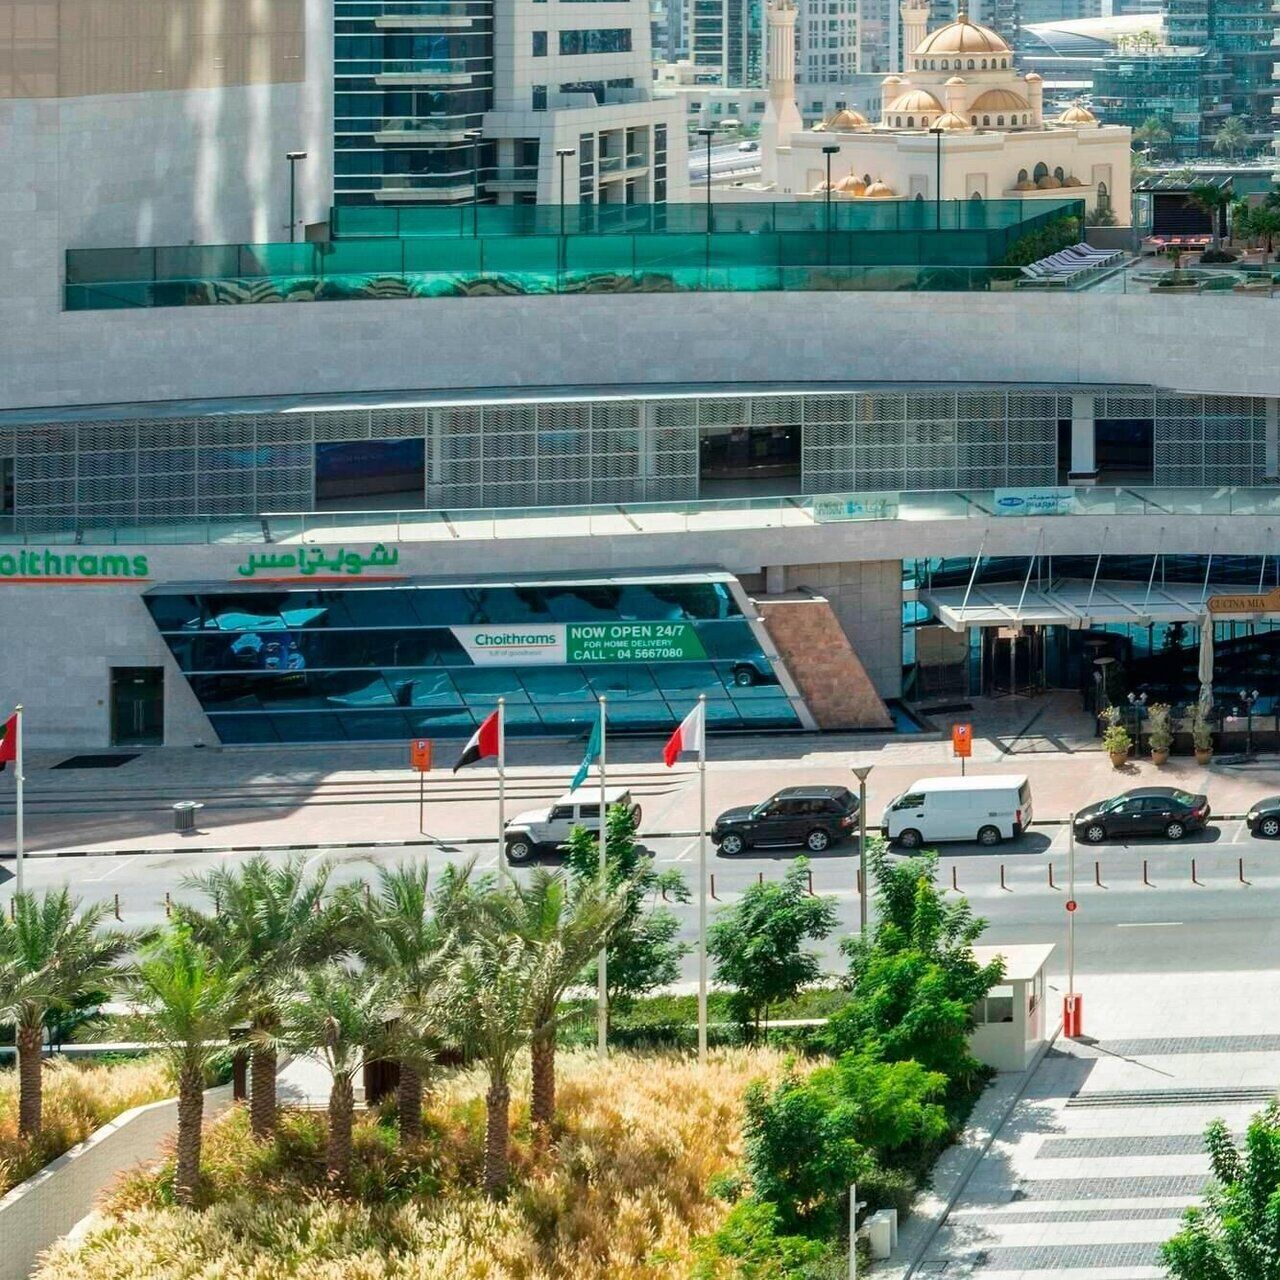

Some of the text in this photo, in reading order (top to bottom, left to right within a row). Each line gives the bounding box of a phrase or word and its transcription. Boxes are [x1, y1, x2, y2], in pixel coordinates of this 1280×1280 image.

[0, 548, 148, 576] oithrams
[475, 632, 556, 646] Choithrams
[571, 625, 685, 639] NOW OPEN 24/7
[584, 639, 673, 649] FOR HOME DELIVERY
[573, 650, 606, 660] CALL
[617, 649, 631, 659] 04
[634, 648, 684, 659] 5667080
